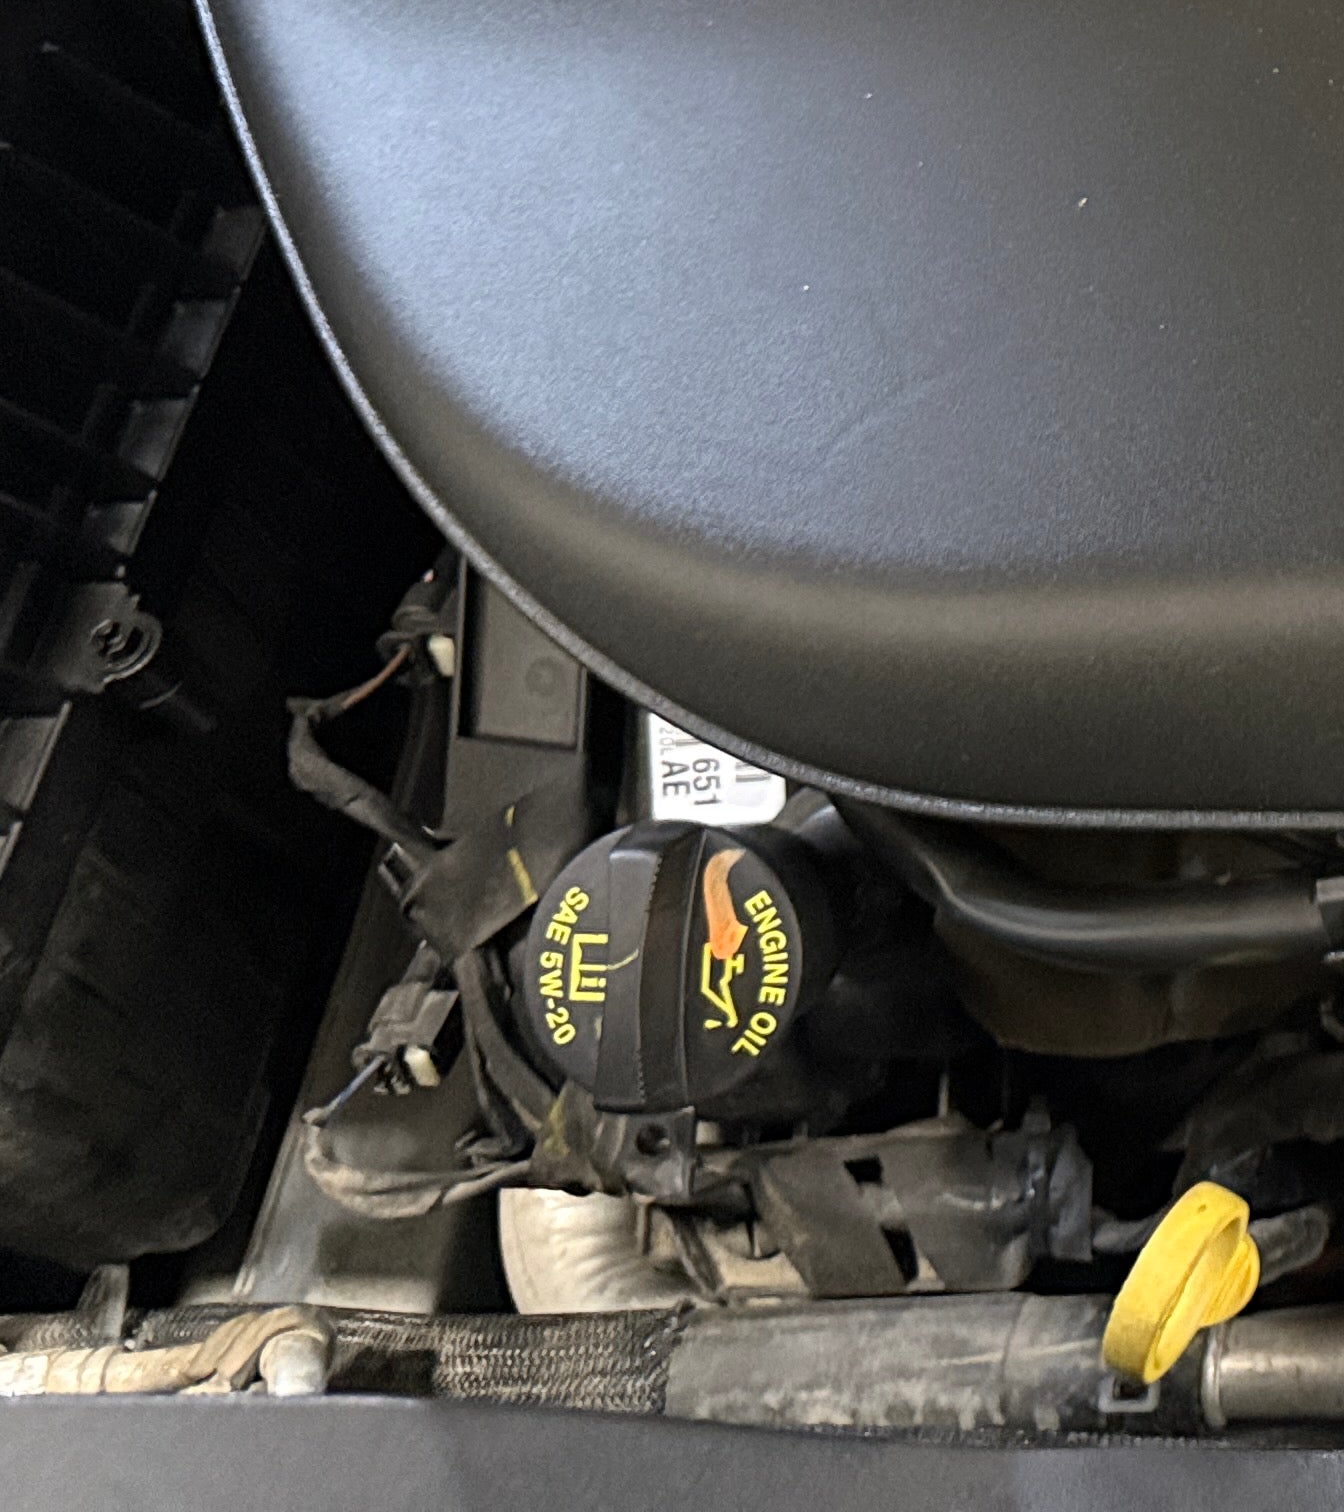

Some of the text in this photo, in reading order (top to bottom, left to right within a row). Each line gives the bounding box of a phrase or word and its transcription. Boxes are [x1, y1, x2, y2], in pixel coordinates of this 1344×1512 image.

[661, 759, 691, 798] AE
[692, 757, 722, 806] 651
[537, 885, 589, 1047] SAE 5W-20
[730, 889, 790, 1059] ENGINE OIL
